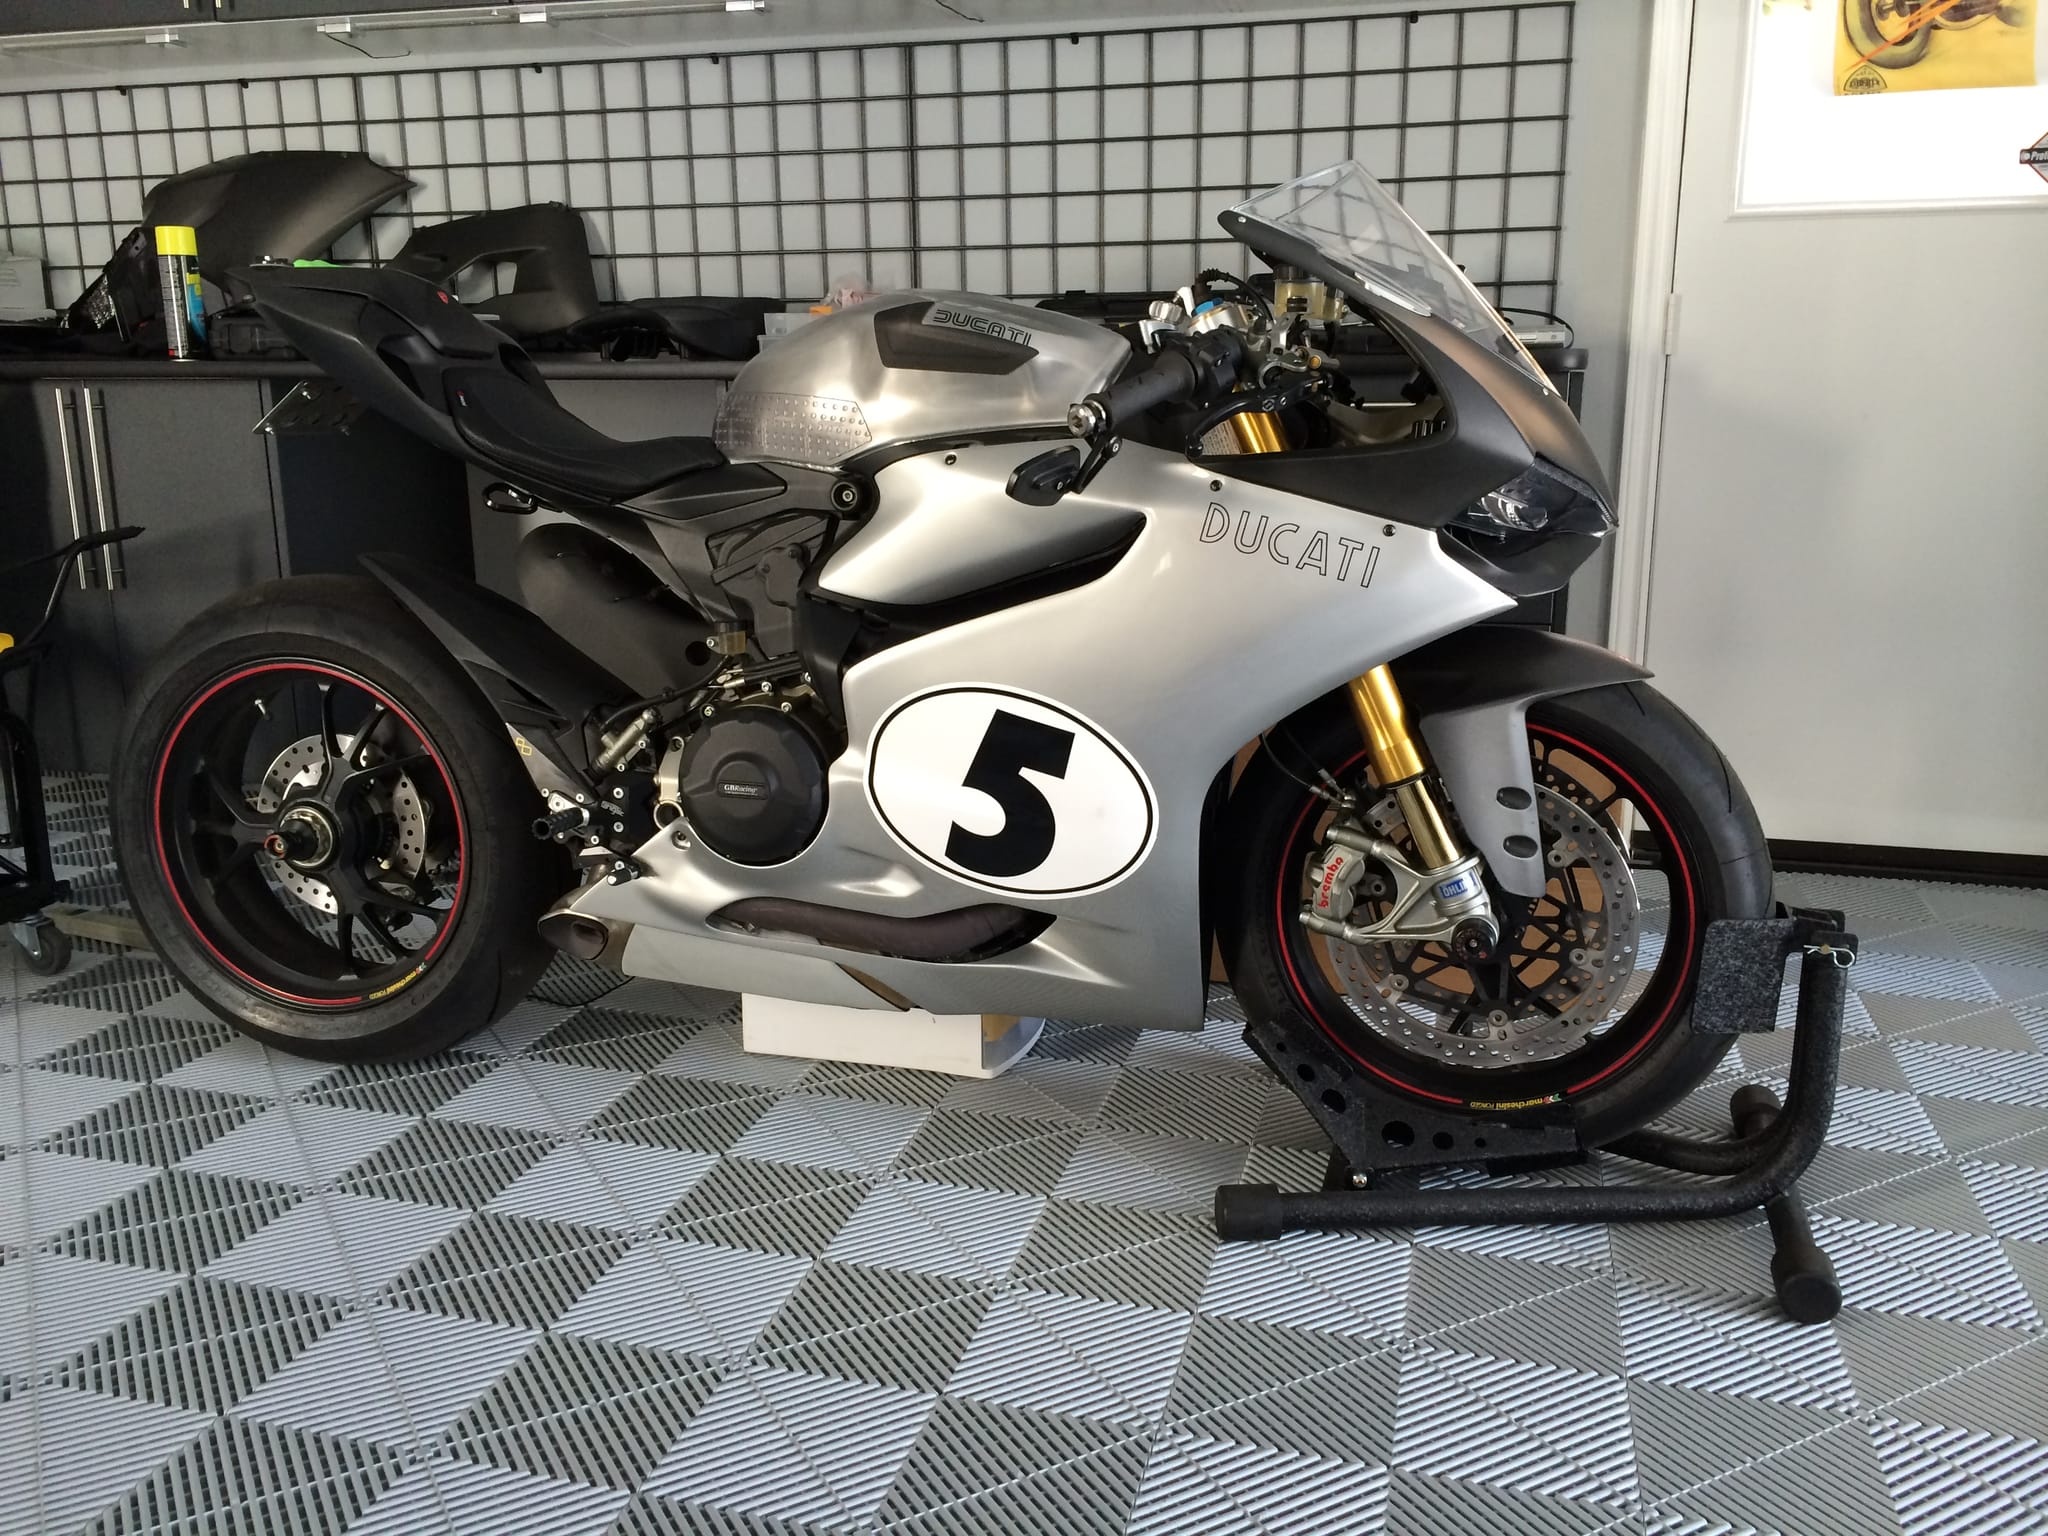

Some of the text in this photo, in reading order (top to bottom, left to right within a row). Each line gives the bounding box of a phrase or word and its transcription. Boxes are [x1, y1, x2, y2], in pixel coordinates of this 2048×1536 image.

[933, 309, 1032, 346] DUCATI
[1200, 502, 1380, 588] DUCATI
[945, 709, 1075, 877] 5
[1317, 857, 1344, 908] brembo
[1496, 1097, 1543, 1111] marchesini
